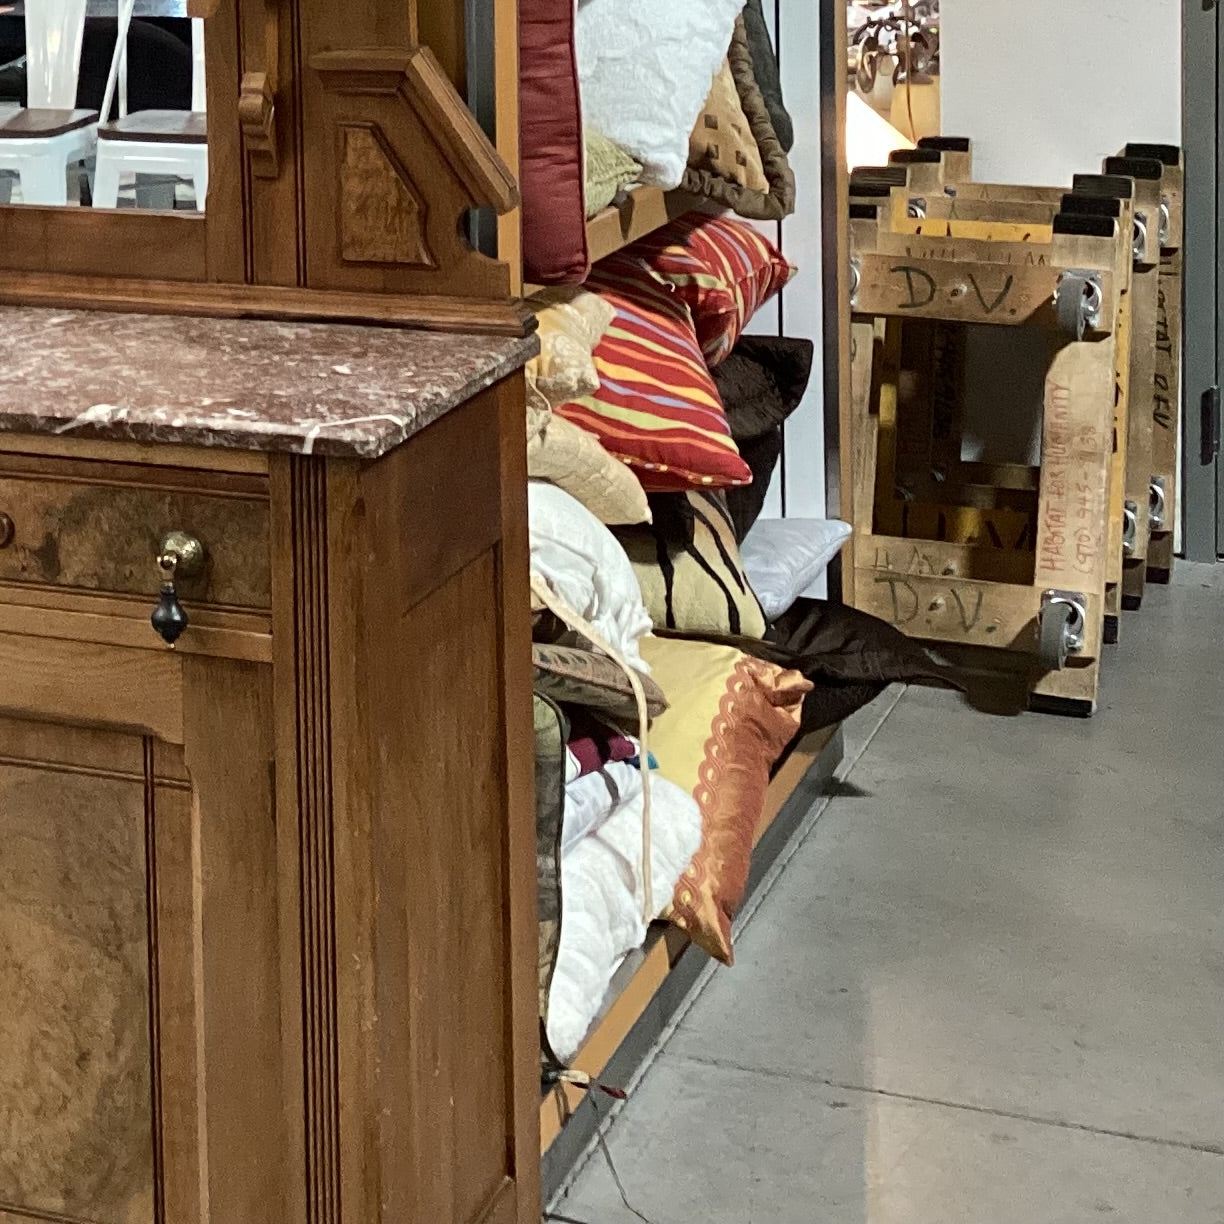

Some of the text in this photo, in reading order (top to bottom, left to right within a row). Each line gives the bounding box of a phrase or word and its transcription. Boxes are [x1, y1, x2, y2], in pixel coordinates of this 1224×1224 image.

[1040, 378, 1071, 572] HABITAT FOR HUMANITY
[1071, 526, 1095, 575] (970)
